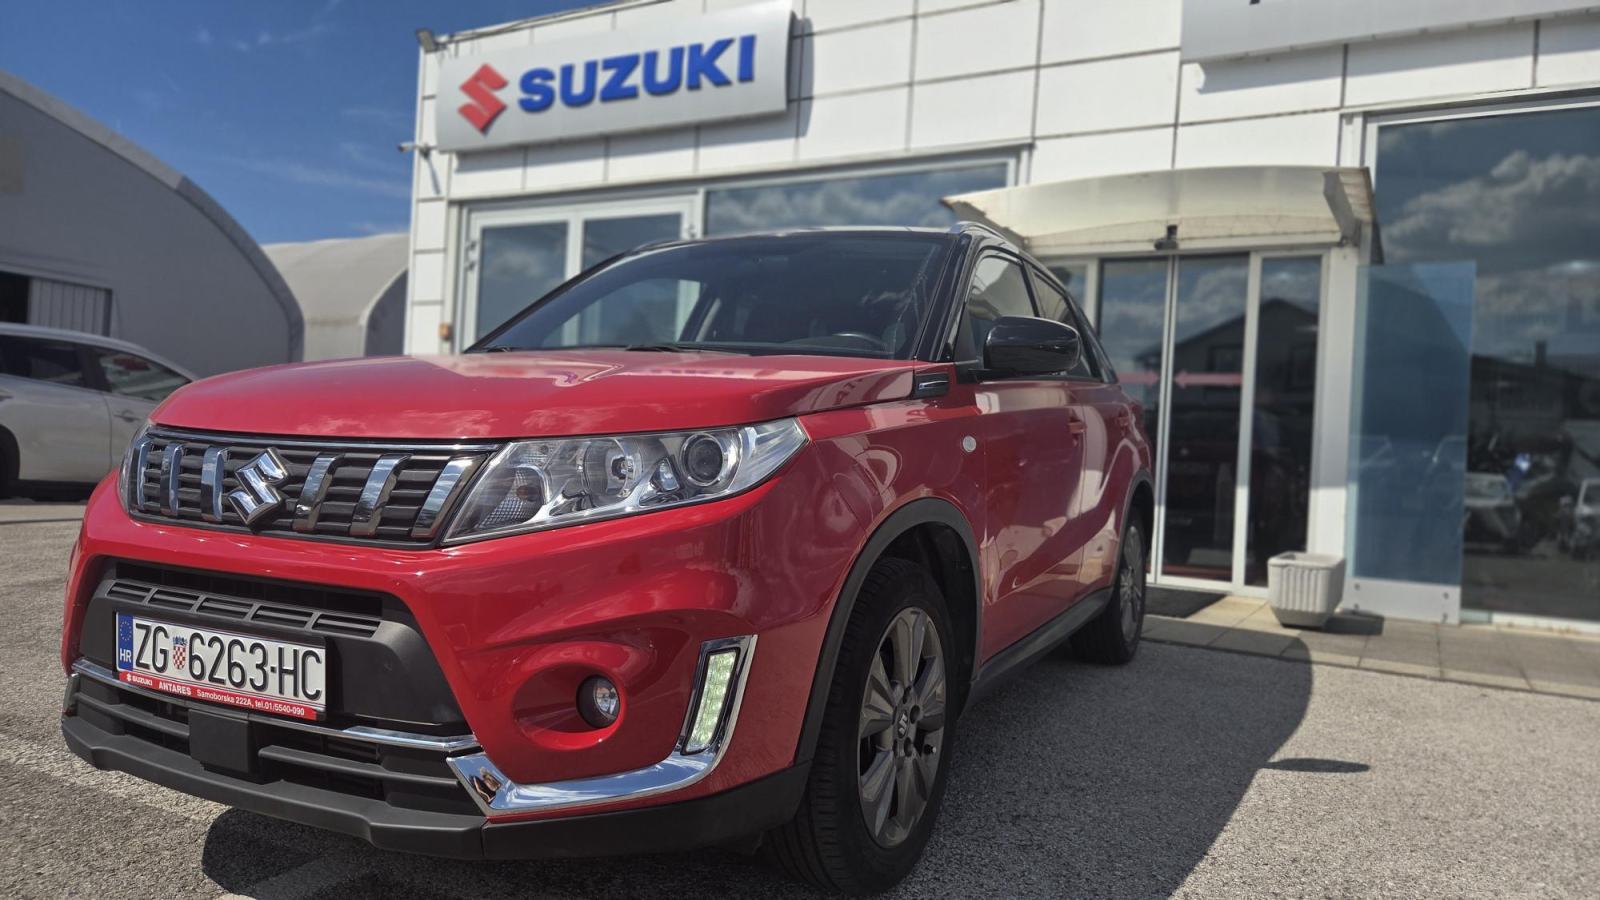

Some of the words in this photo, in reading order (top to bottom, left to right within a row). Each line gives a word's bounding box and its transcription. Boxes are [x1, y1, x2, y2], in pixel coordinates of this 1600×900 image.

[518, 34, 757, 113] SUZUKI
[119, 647, 132, 664] HR
[135, 622, 170, 674] ZG
[188, 632, 322, 700] 6263-HC
[132, 675, 153, 686] SUZUKI
[158, 681, 192, 696] ANTARES
[196, 689, 235, 704] Samoborska
